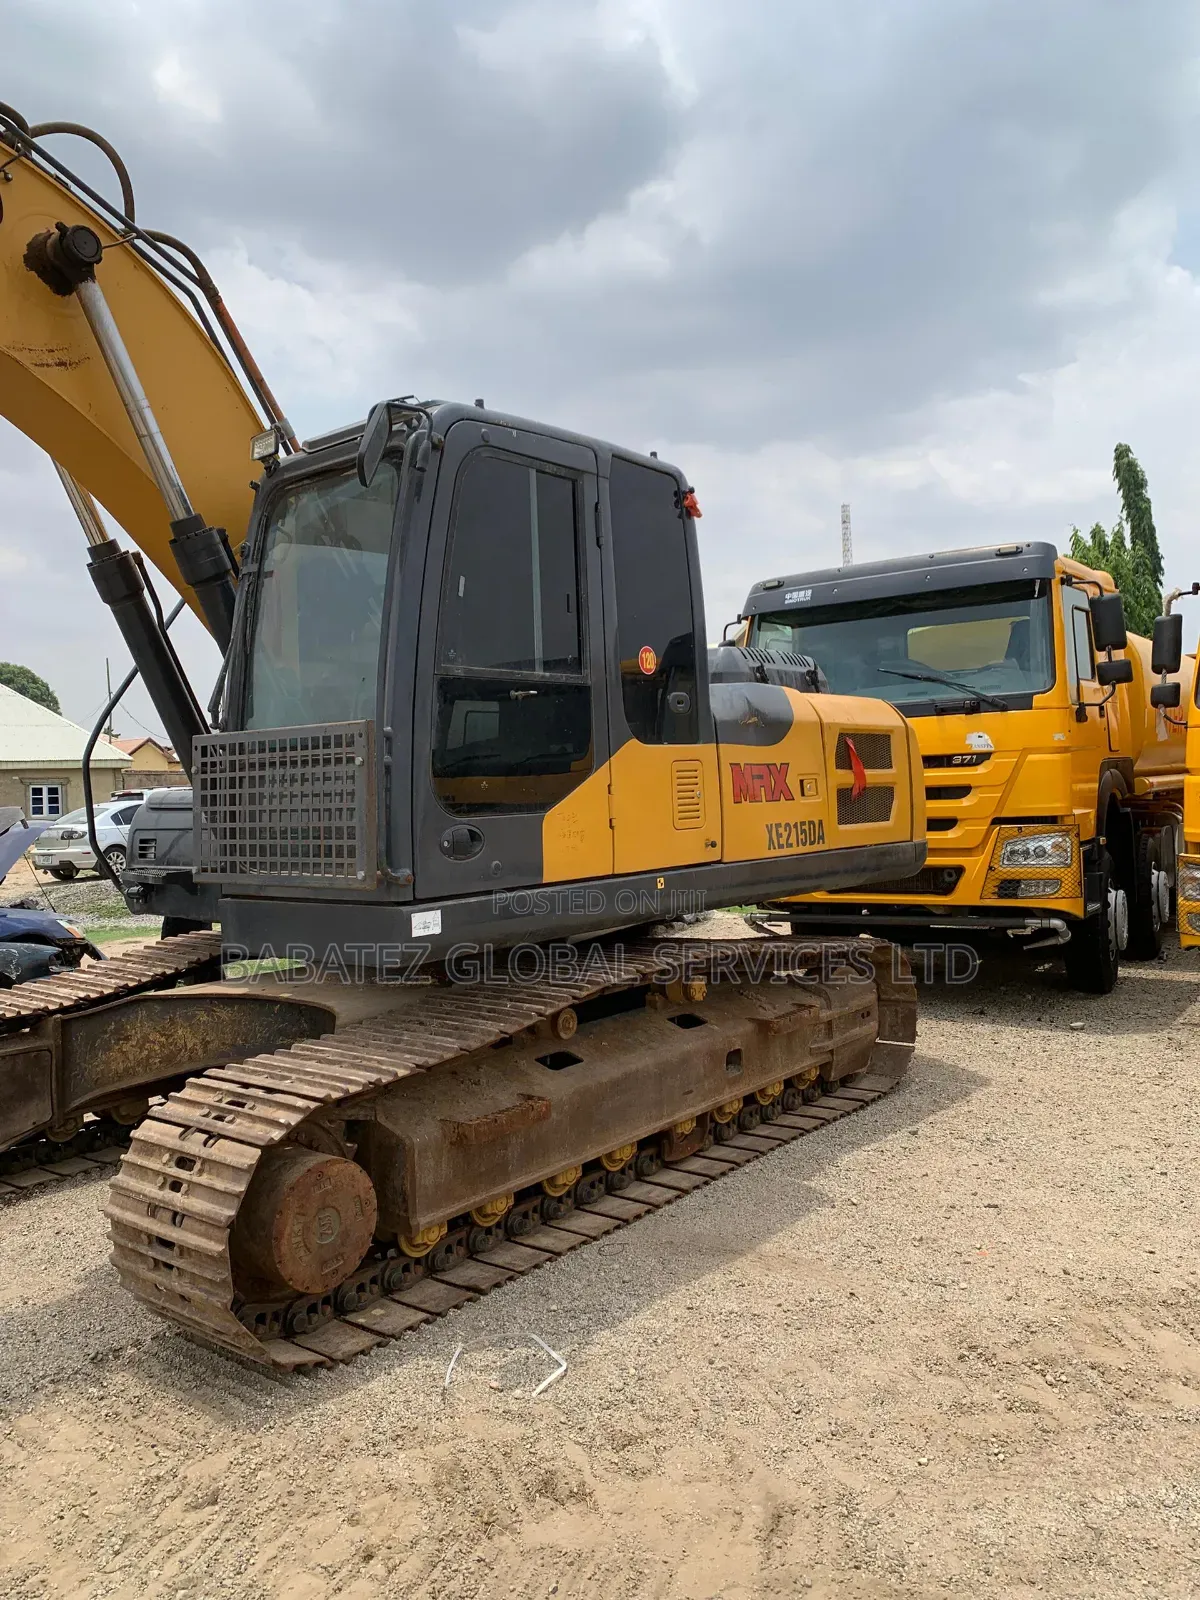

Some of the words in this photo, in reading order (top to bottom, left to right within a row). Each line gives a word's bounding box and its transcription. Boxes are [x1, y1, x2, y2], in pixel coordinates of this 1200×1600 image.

[642, 651, 655, 669] 120
[952, 754, 977, 764] 371
[729, 762, 795, 804] MAX
[765, 819, 825, 850] XE215DA
